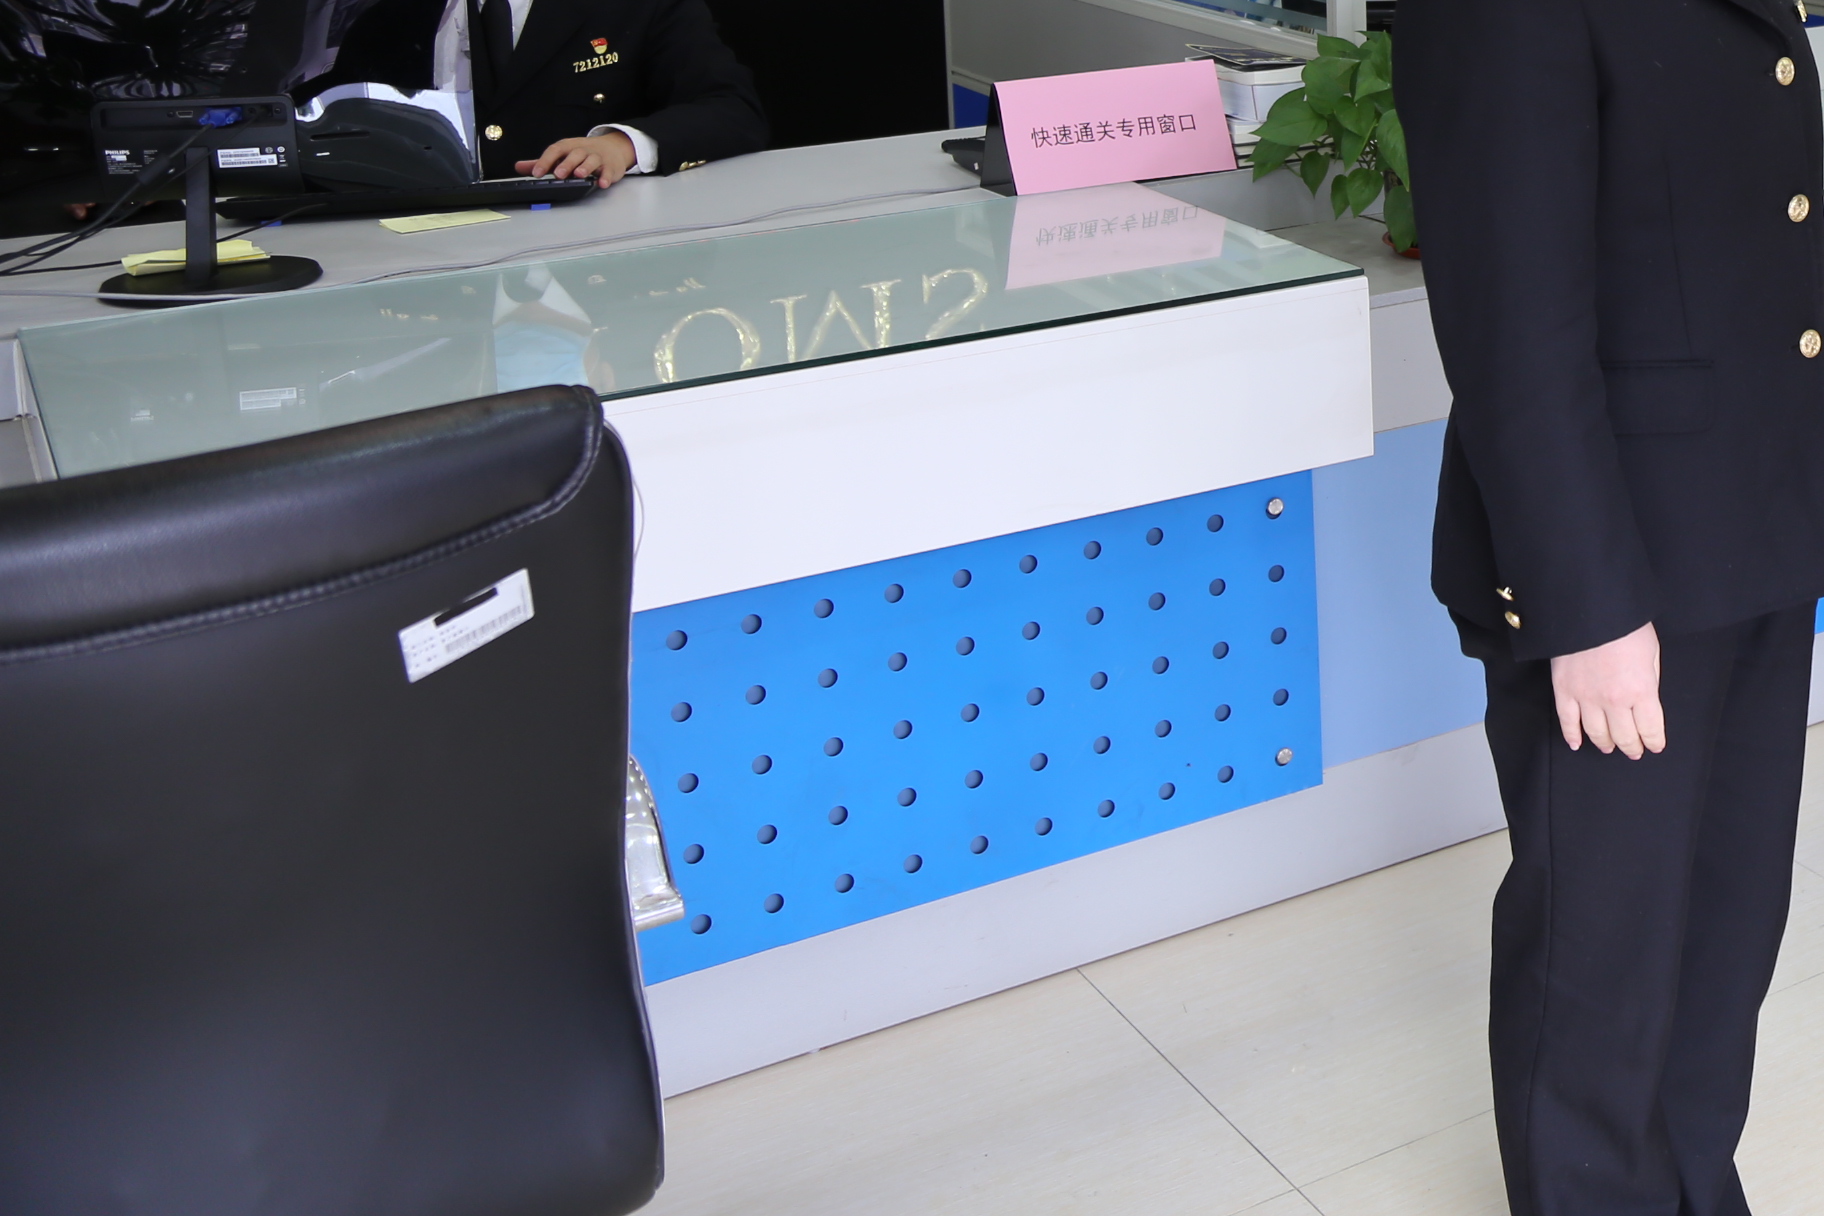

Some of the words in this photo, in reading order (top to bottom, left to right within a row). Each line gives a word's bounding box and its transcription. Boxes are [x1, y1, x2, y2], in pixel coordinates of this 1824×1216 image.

[572, 51, 619, 73] 7212120
[1030, 112, 1198, 149] 快速通关专用窗口
